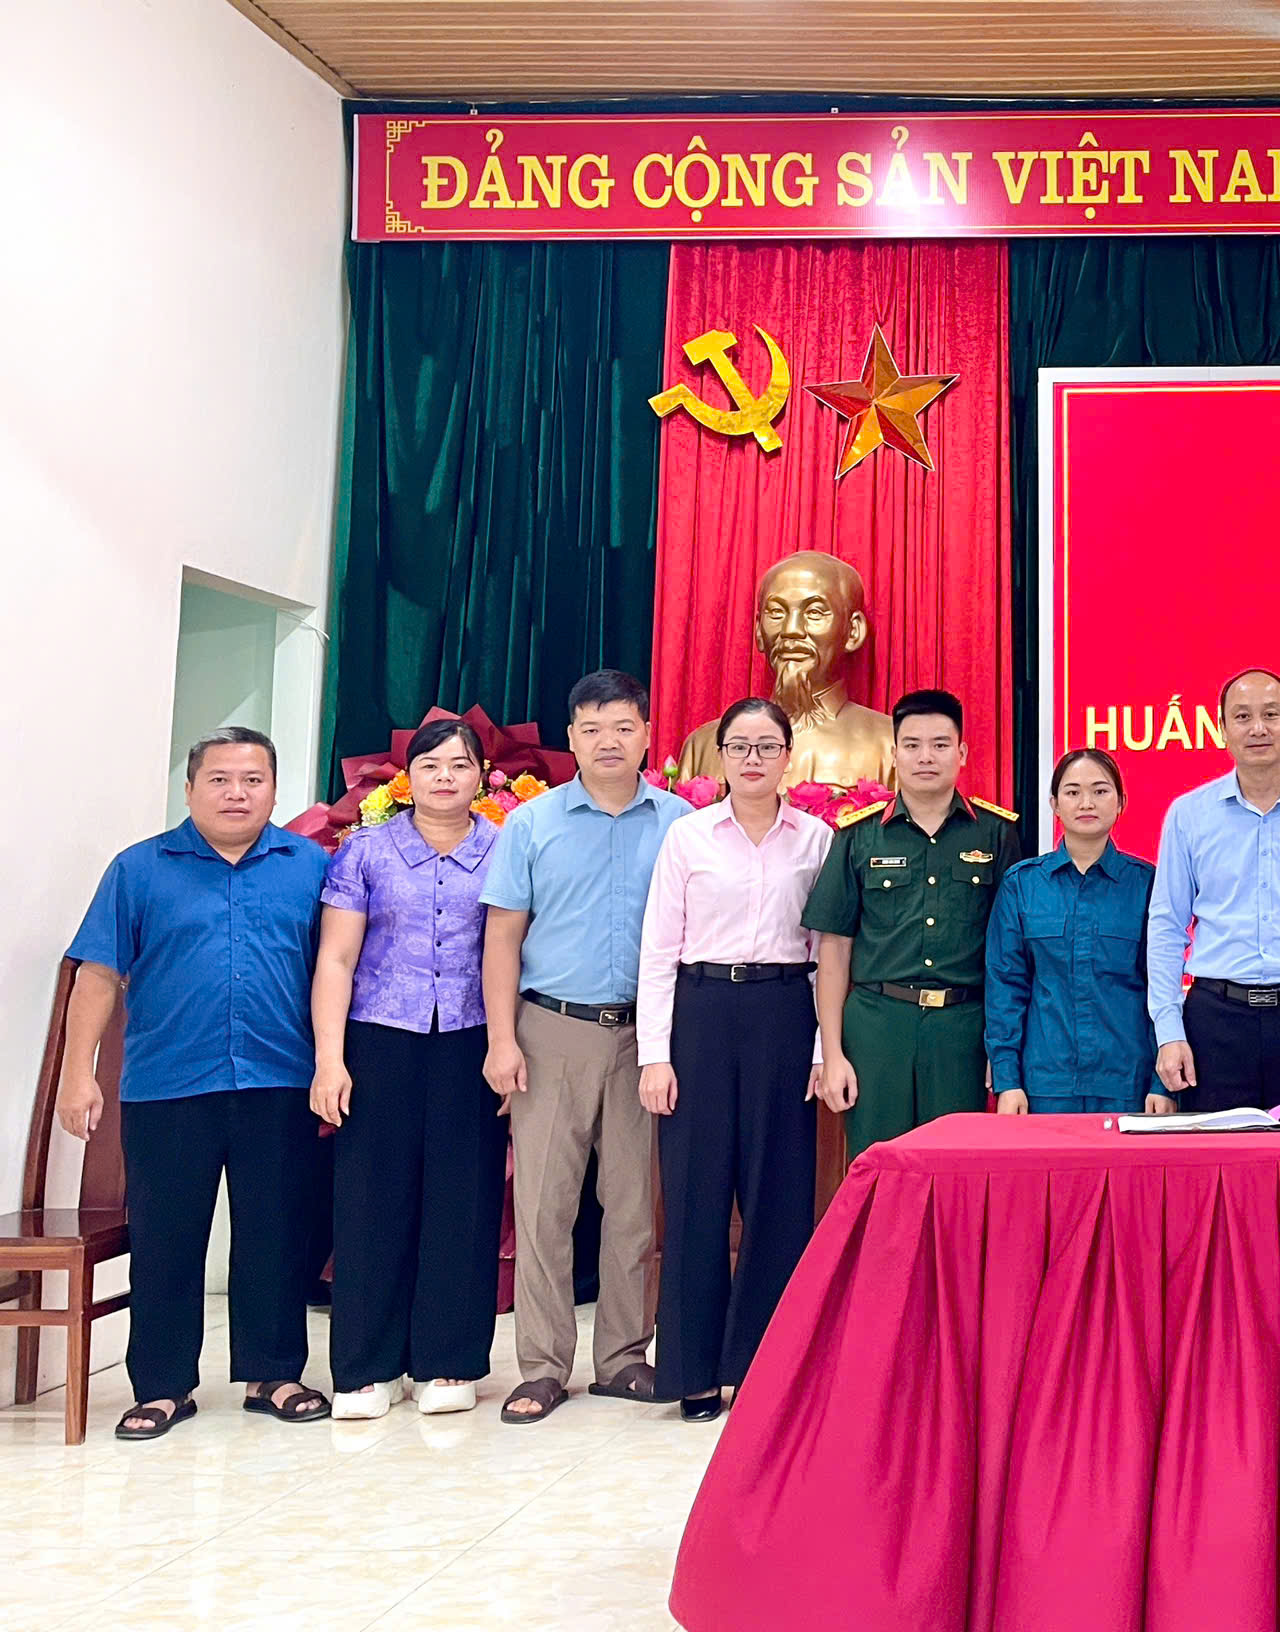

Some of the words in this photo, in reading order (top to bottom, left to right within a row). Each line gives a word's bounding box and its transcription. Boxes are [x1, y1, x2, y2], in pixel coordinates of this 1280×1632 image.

[421, 129, 615, 210] ĐẢNG
[633, 135, 819, 223] CỘNG
[837, 127, 972, 206] SẢN
[992, 132, 1149, 220] VIỆT
[1086, 695, 1226, 751] HUẤN
